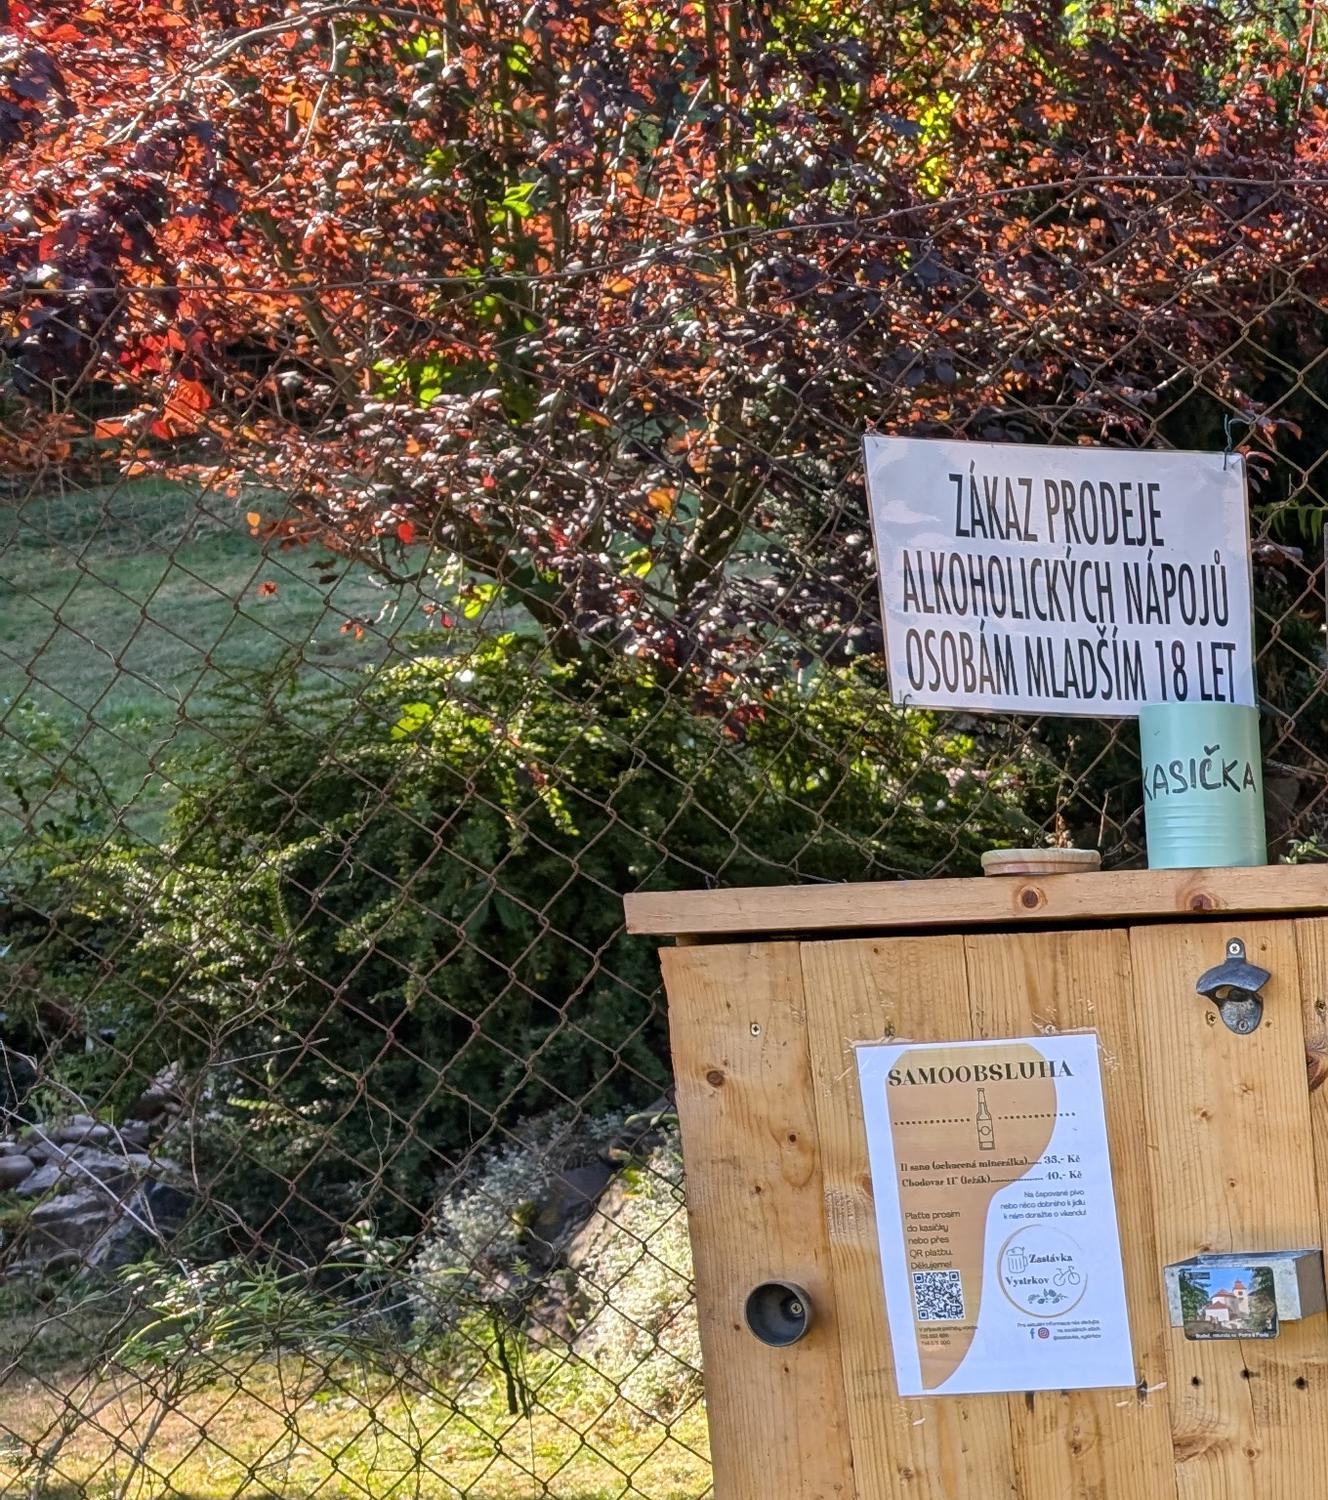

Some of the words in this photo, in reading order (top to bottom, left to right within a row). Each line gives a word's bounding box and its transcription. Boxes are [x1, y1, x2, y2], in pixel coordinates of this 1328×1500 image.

[949, 460, 1039, 542] ZÁKAZ
[1045, 479, 1164, 547] PRODEJE
[902, 545, 1115, 624] ALKOHOLICKÝCH
[1124, 549, 1229, 627] NÁPOJŮ
[905, 618, 1019, 697] OSOBÁM
[1025, 625, 1147, 702] MLADŠÍM
[1154, 640, 1187, 702] 18
[1197, 641, 1236, 704] LET
[887, 1060, 1074, 1087] SAMOOBSLUHA
[902, 1177, 944, 1188] Chodovar
[932, 1209, 960, 1220] prosím
[907, 1224, 917, 1233] do
[919, 1223, 949, 1233] kasičky
[908, 1236, 929, 1245] nebo
[930, 1235, 950, 1246] přes
[909, 1249, 923, 1258] QR
[1029, 1252, 1073, 1264] Zastávka
[910, 1260, 953, 1270] Děkujeme!
[1005, 1275, 1050, 1288] Vystrkov
